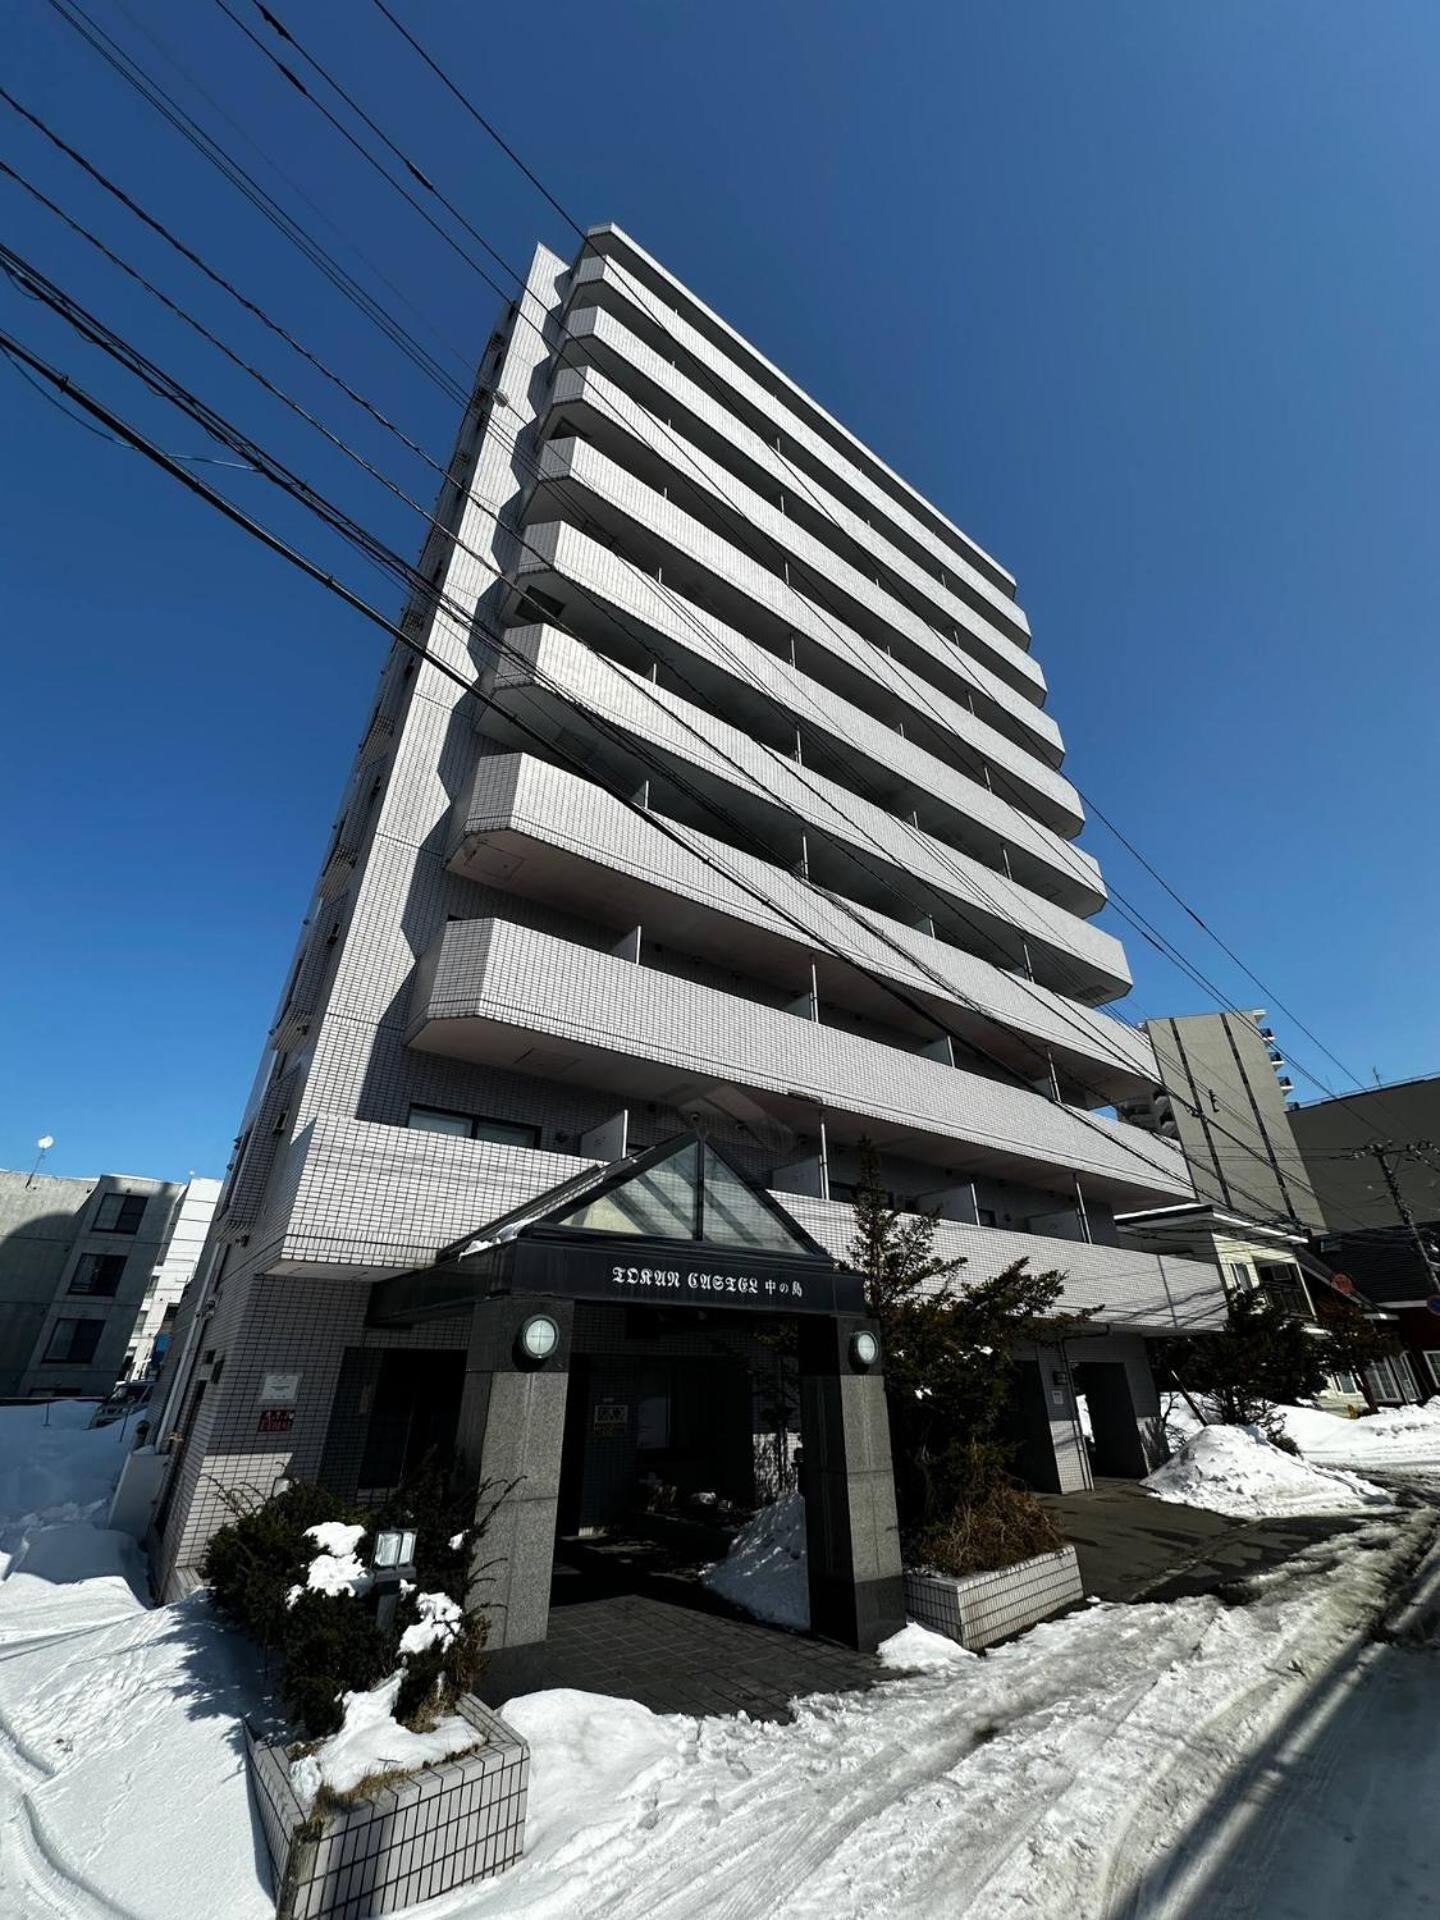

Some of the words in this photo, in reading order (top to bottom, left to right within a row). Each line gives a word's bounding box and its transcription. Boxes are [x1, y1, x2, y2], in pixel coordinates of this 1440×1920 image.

[612, 1266, 681, 1288] TOKAN
[687, 1271, 758, 1294] CASTEL
[765, 1279, 802, 1297] 中の島
